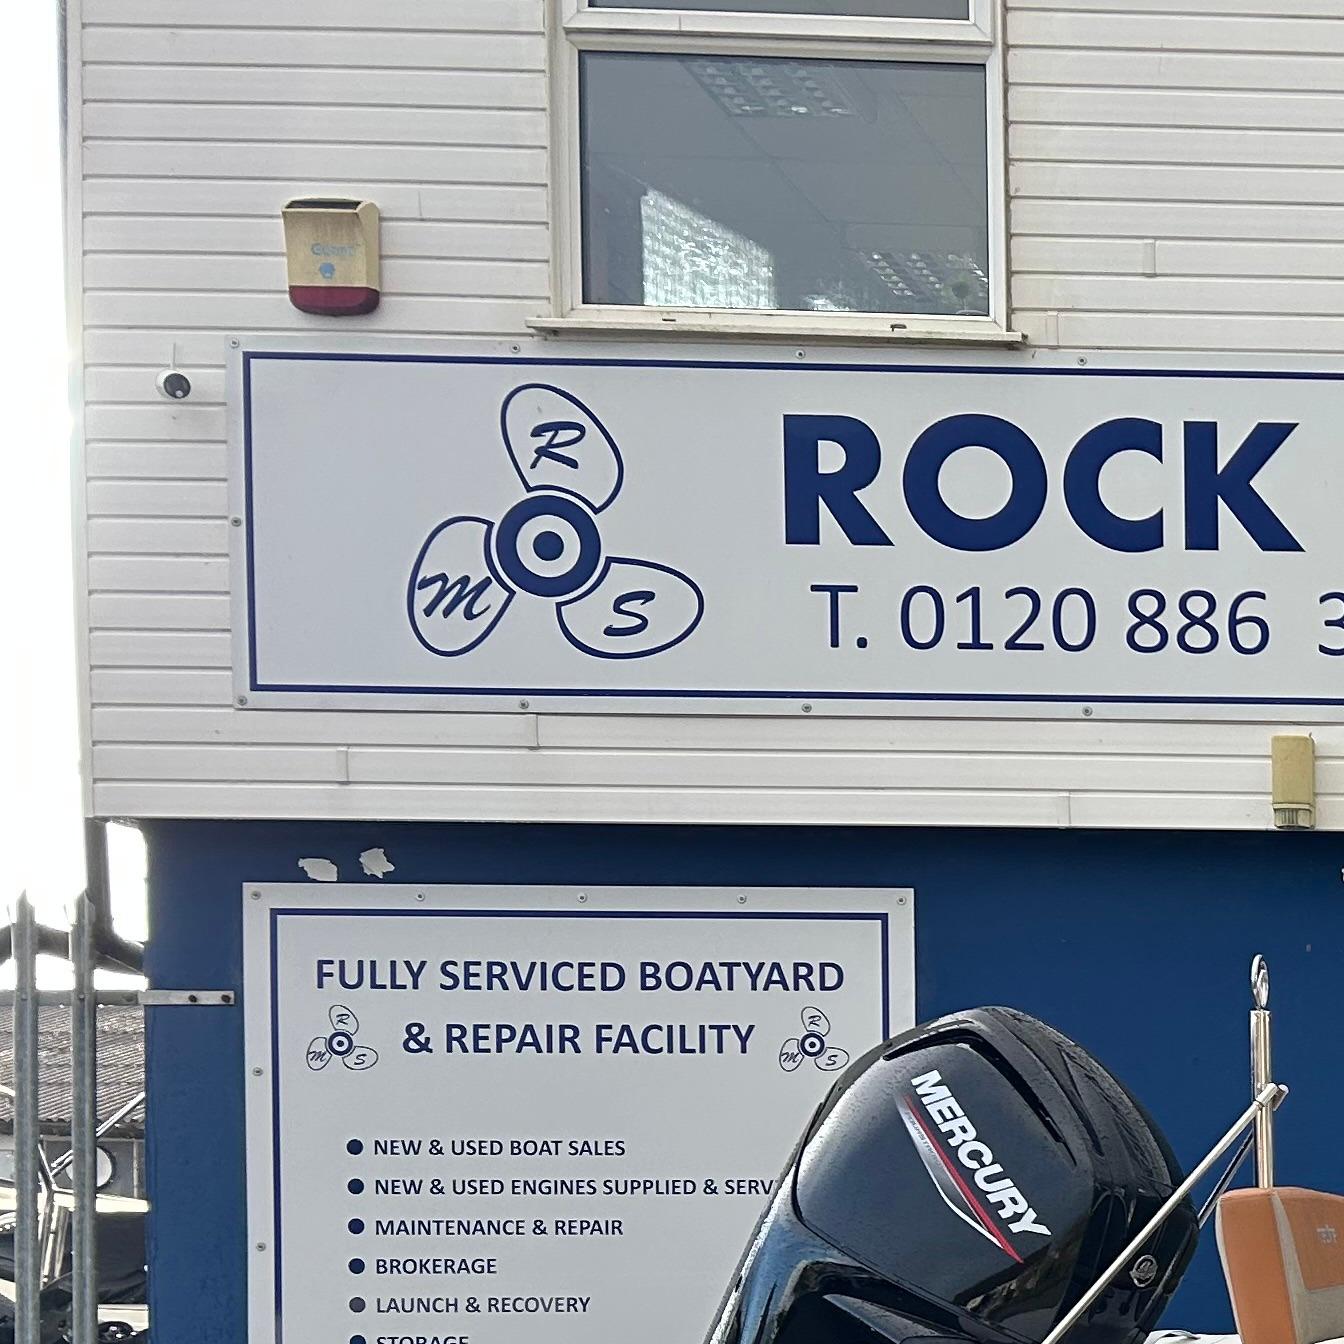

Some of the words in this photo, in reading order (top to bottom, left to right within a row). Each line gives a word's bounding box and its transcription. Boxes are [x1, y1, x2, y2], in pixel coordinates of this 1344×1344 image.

[530, 420, 586, 469] R
[783, 414, 1305, 552] ROCK
[603, 590, 656, 637] S
[811, 585, 867, 648] T.
[901, 586, 1096, 652] 0120
[1127, 589, 1269, 655] 886
[317, 960, 427, 990] FULLY
[440, 961, 625, 991] SERVICED
[641, 962, 844, 992] BOATYARD
[403, 1023, 433, 1054] &
[446, 1024, 581, 1054] REPAIR
[596, 1025, 756, 1055] FACILITY
[375, 1139, 423, 1155] NEW
[429, 1139, 445, 1156] &
[452, 1140, 503, 1156] USED
[511, 1140, 563, 1156] BOAT
[568, 1140, 626, 1156] SALES
[911, 1069, 1052, 1236] MERCURY
[376, 1179, 423, 1195] NEW
[430, 1179, 445, 1195] &
[453, 1180, 504, 1195] USED
[512, 1180, 597, 1195] ENGINES
[603, 1180, 697, 1195] SUPPLIED
[703, 1179, 719, 1195] &
[725, 1180, 777, 1195] SERV
[376, 1219, 525, 1235] MAINTENANCE
[532, 1219, 548, 1236] &
[555, 1219, 624, 1236] REPAIR
[376, 1259, 497, 1275] BROKERAGE
[377, 1297, 459, 1313] LAUNCH
[466, 1297, 481, 1313] &
[488, 1297, 591, 1313] RECOVERY
